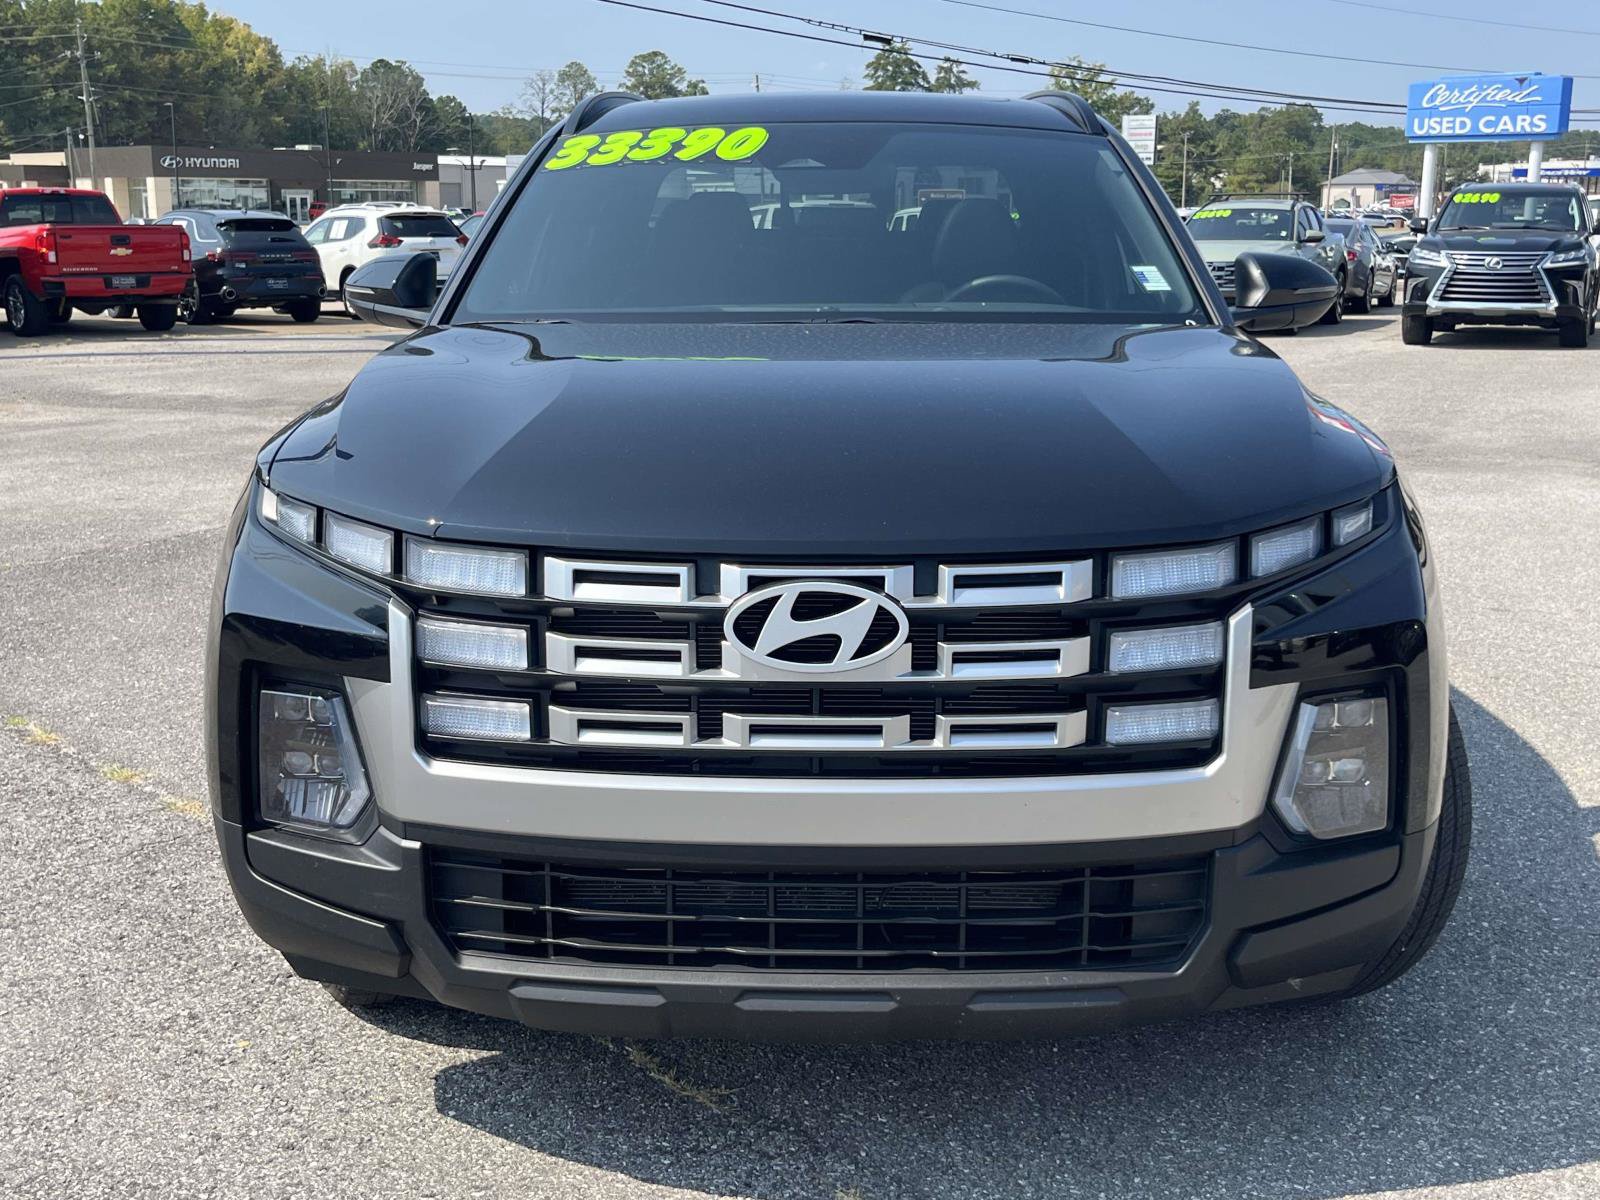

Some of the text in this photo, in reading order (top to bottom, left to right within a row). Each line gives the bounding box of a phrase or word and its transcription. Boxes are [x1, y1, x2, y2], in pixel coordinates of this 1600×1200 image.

[1421, 83, 1543, 113] Certified
[1413, 114, 1548, 135] USED CARS
[544, 126, 770, 171] 33390
[185, 157, 240, 169] HYUNDAI
